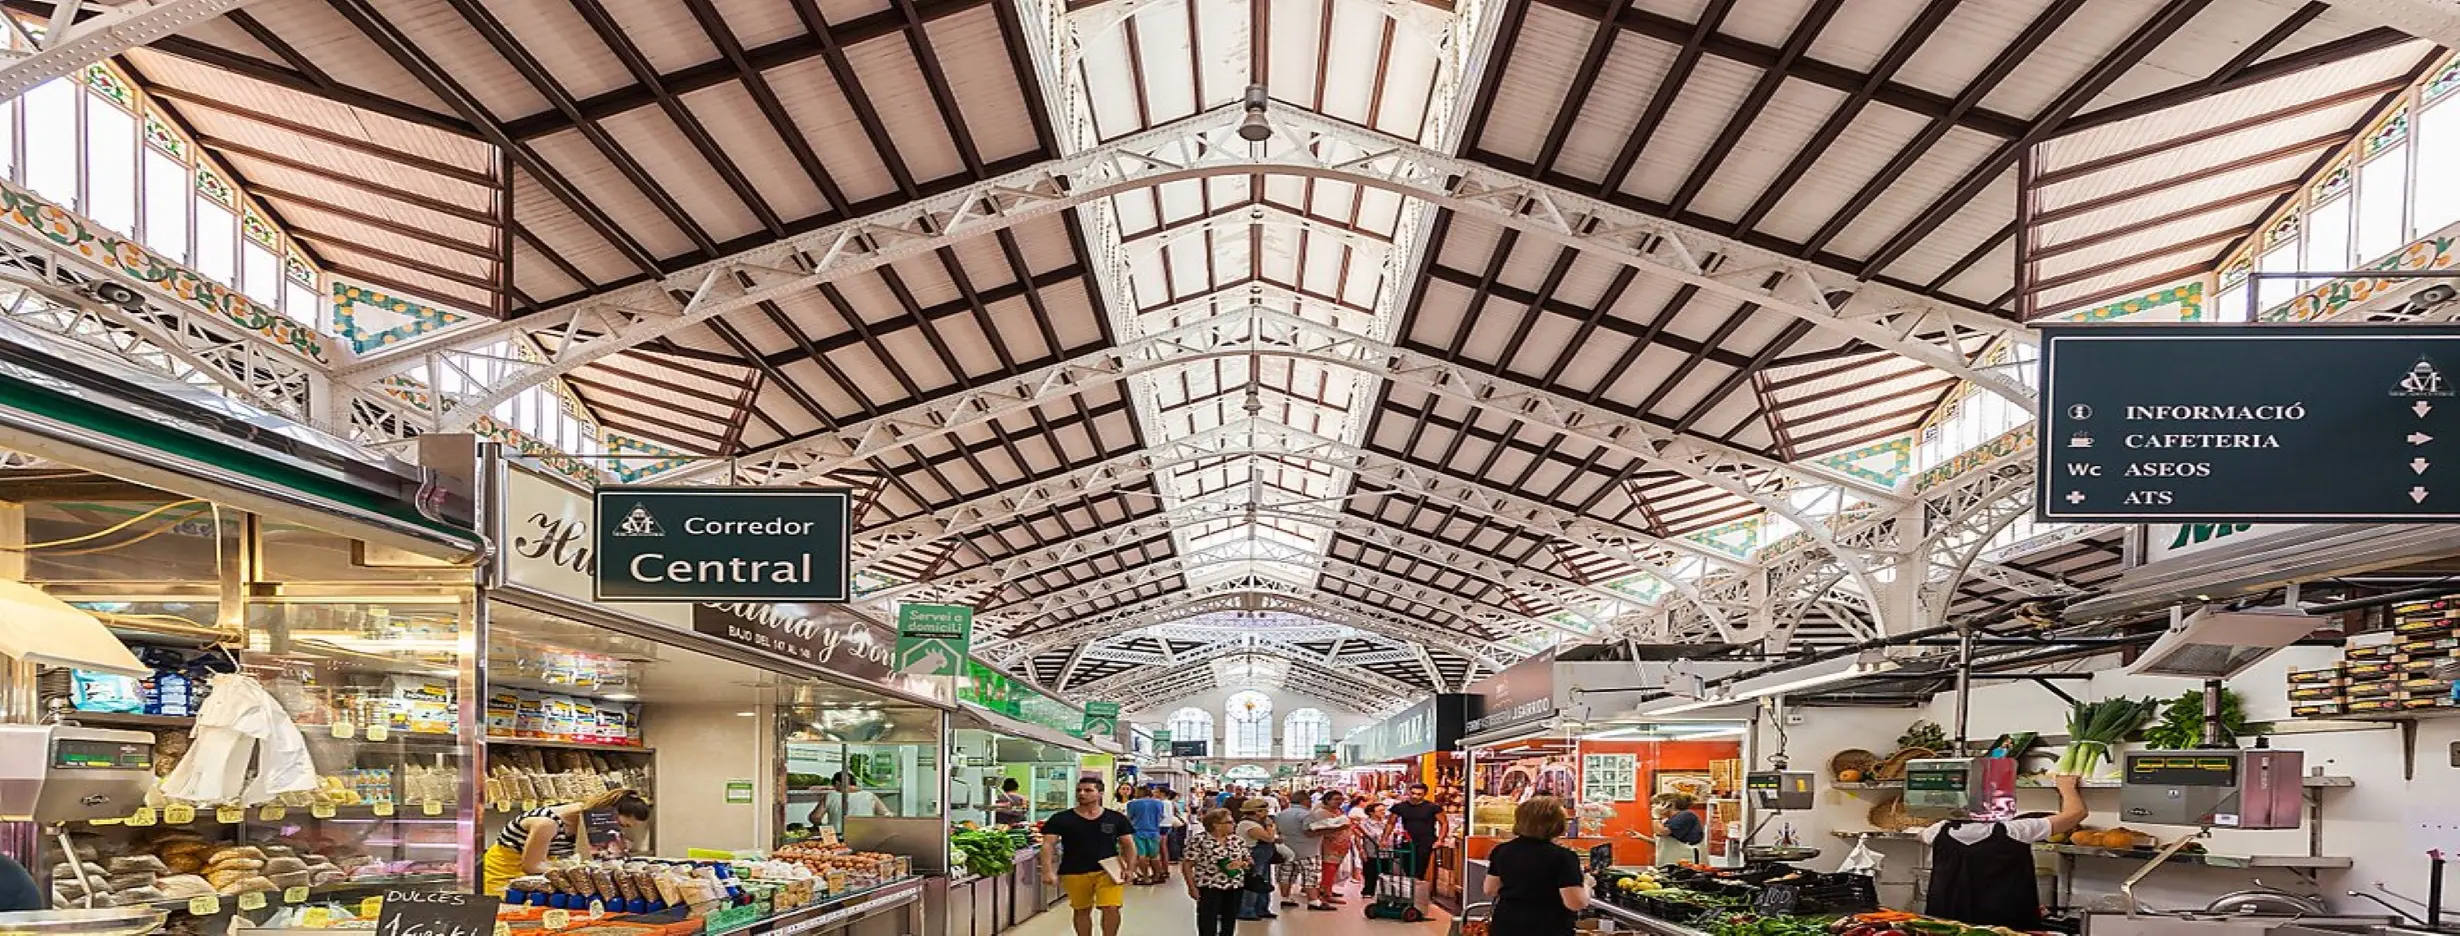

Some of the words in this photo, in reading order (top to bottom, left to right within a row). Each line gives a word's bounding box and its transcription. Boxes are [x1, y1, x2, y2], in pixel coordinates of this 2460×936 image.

[2125, 402, 2306, 420] INFORMACIÓ
[2124, 434, 2280, 449] CAFETERIA
[2067, 463, 2102, 477] Wc
[2124, 462, 2211, 477] ASEOS
[2123, 491, 2174, 505] ATS
[684, 516, 815, 536] Corredor
[629, 553, 811, 584] Central
[702, 602, 819, 641] aura
